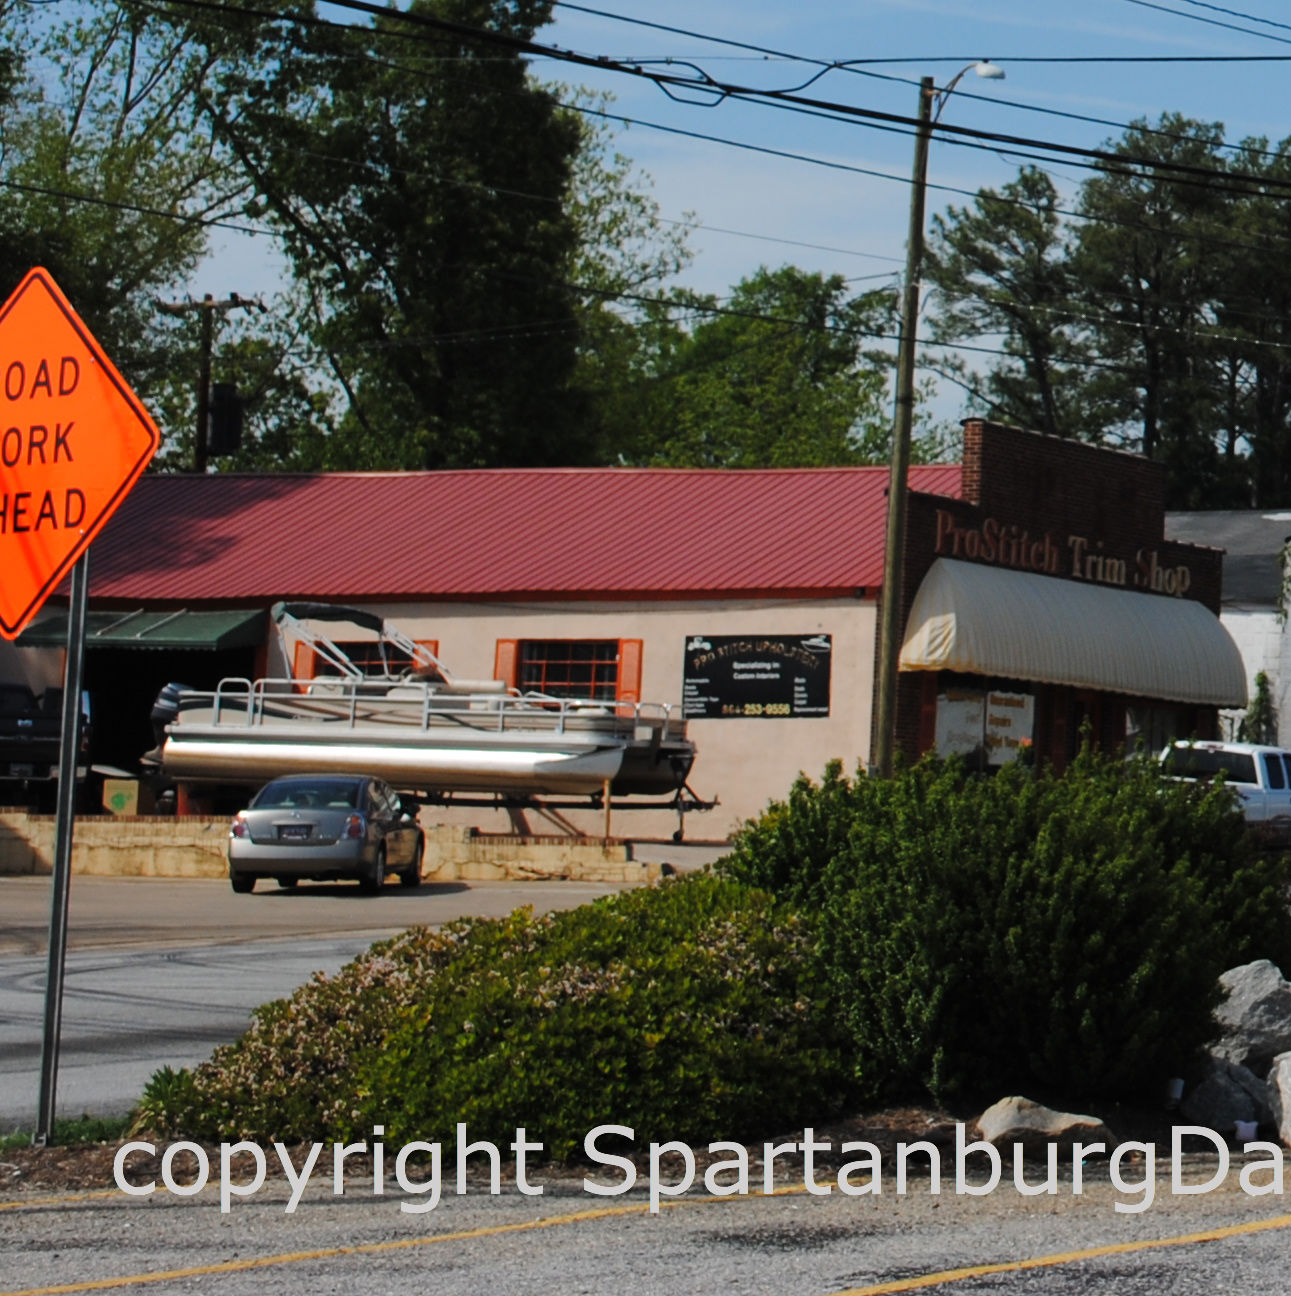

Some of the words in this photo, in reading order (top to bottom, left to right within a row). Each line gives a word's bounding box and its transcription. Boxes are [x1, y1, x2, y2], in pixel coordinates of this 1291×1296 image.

[0, 356, 80, 402] OAD
[0, 421, 75, 468] ORK
[934, 508, 1059, 573] ProStitch
[1067, 535, 1126, 585] Trim
[1134, 548, 1191, 597] Shop
